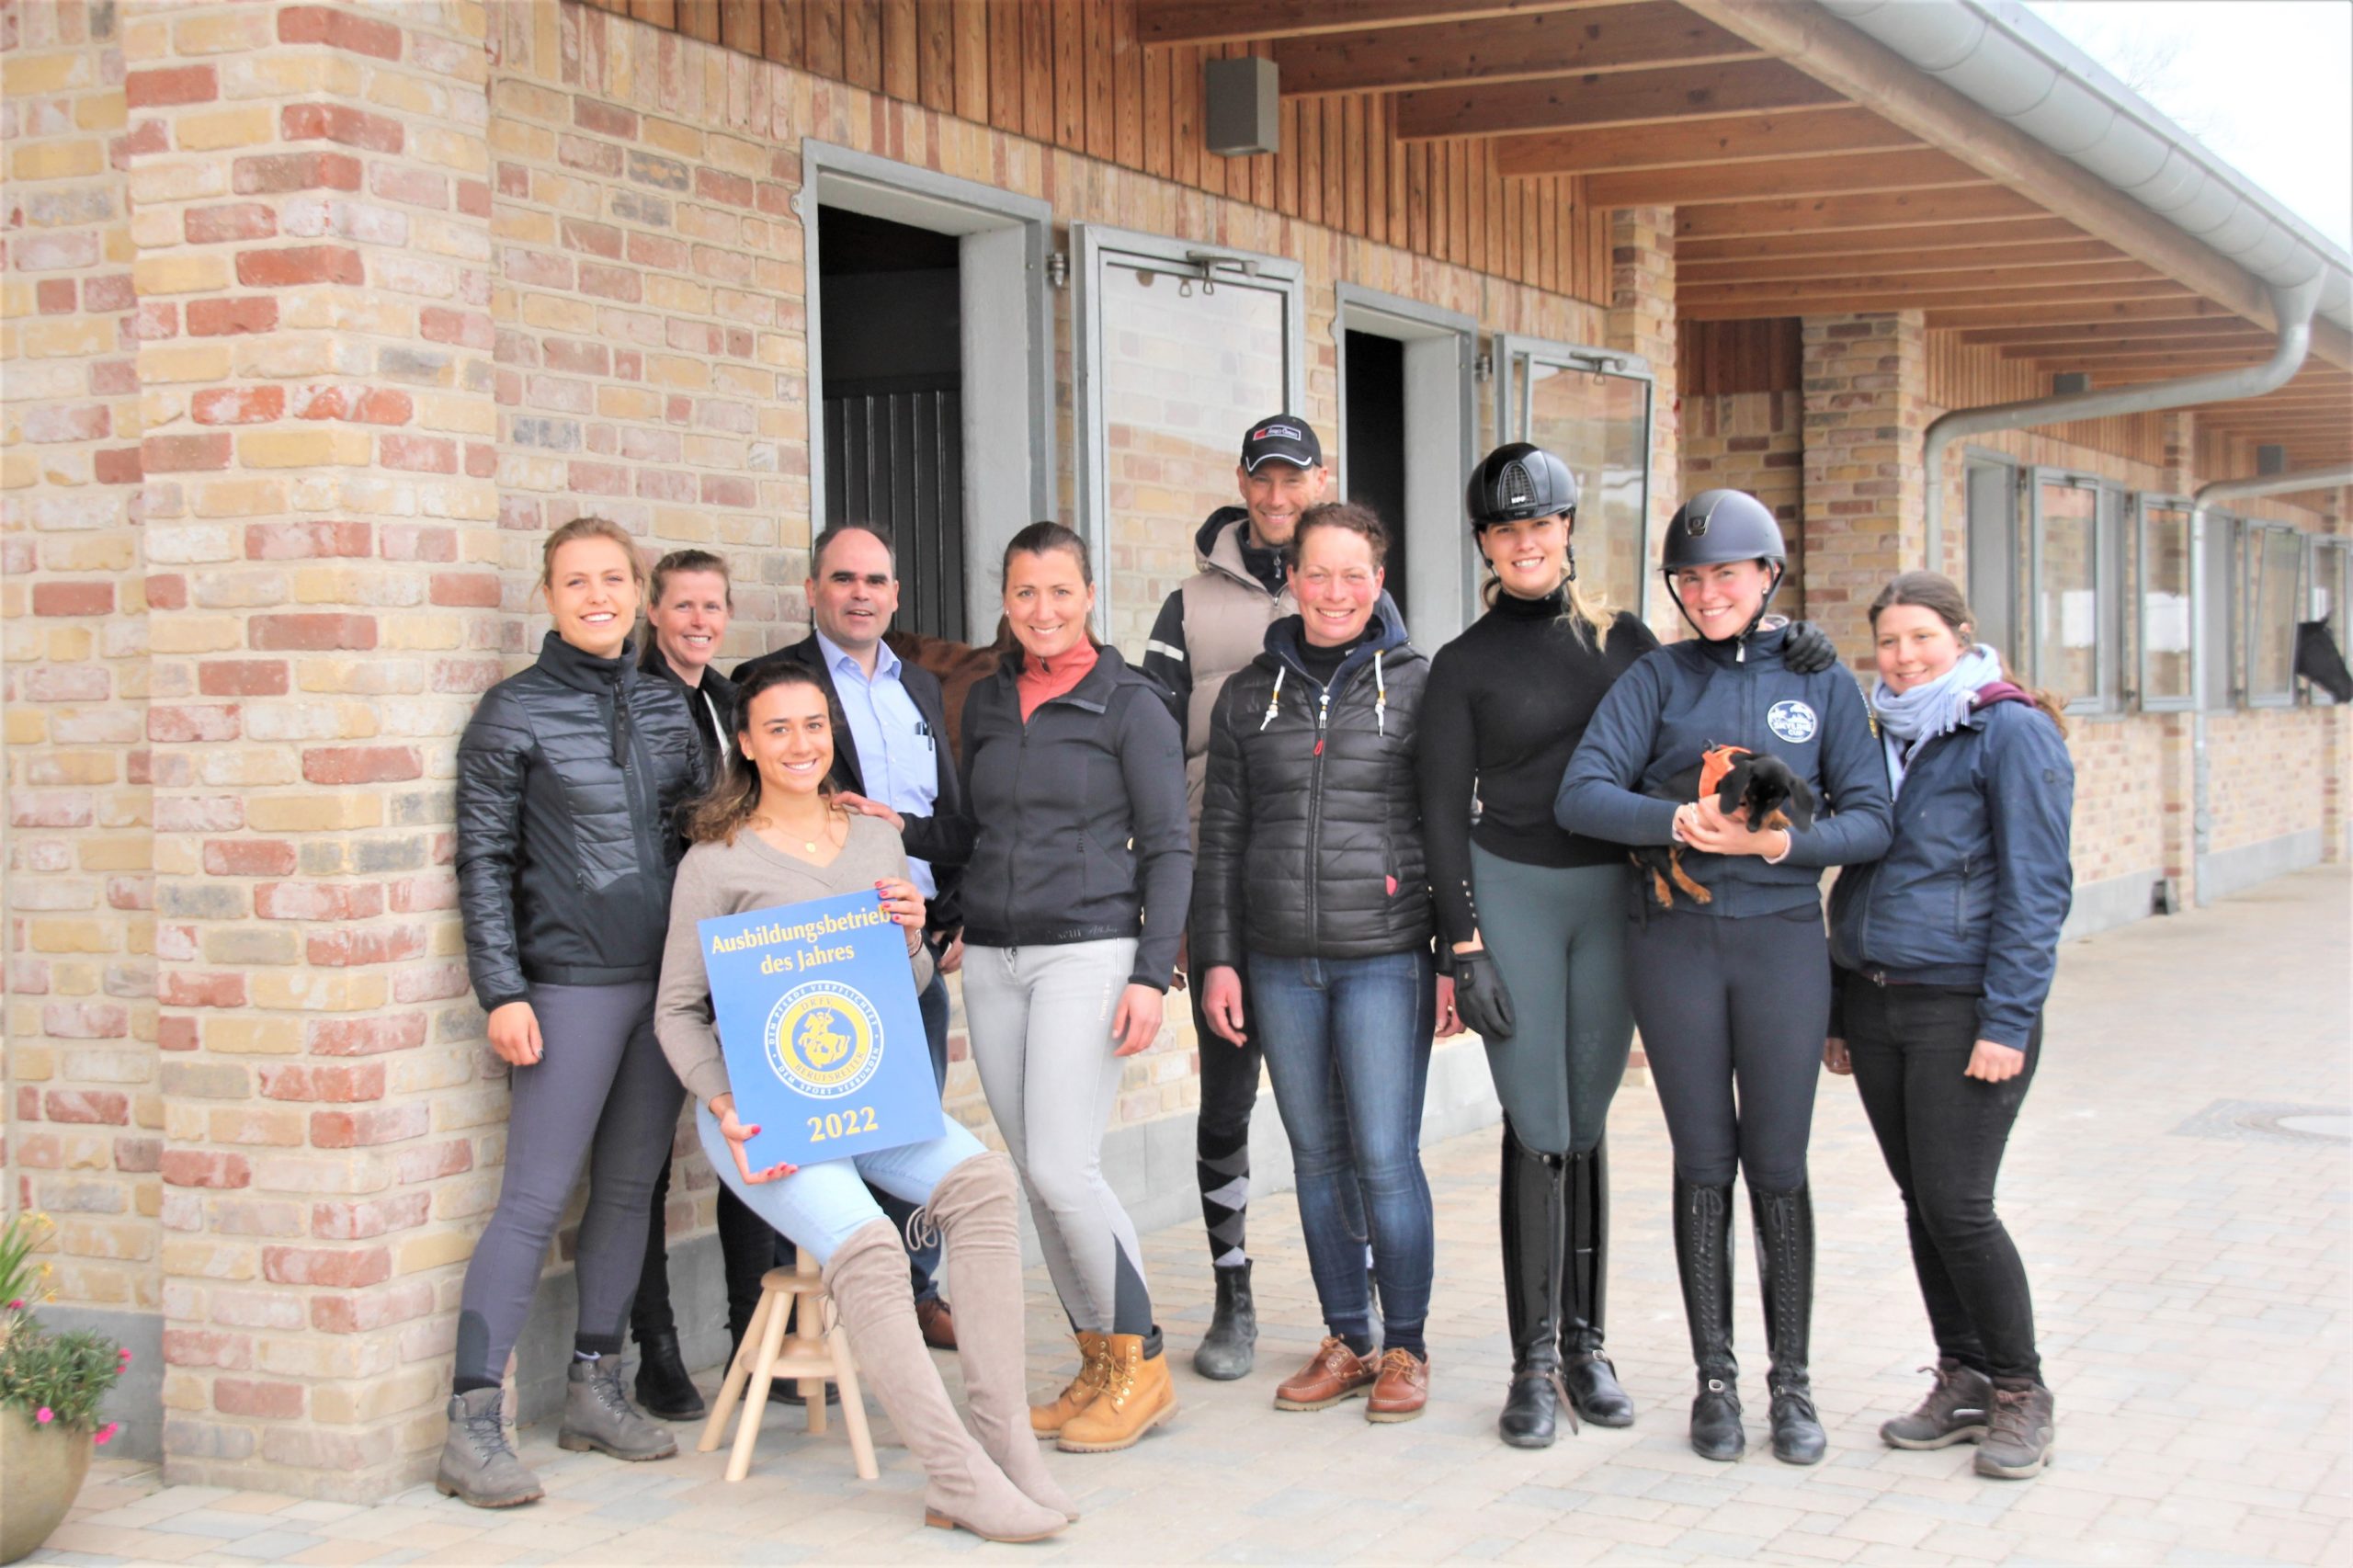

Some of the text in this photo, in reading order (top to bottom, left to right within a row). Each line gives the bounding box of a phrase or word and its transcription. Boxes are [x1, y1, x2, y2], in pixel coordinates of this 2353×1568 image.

[712, 904, 891, 954] Ausbildungsbetrieb
[761, 945, 855, 974] des Jahres
[795, 1051, 864, 1082] BERUFSREITER
[800, 1084, 832, 1096] SPORT
[807, 1106, 879, 1142] 2022
